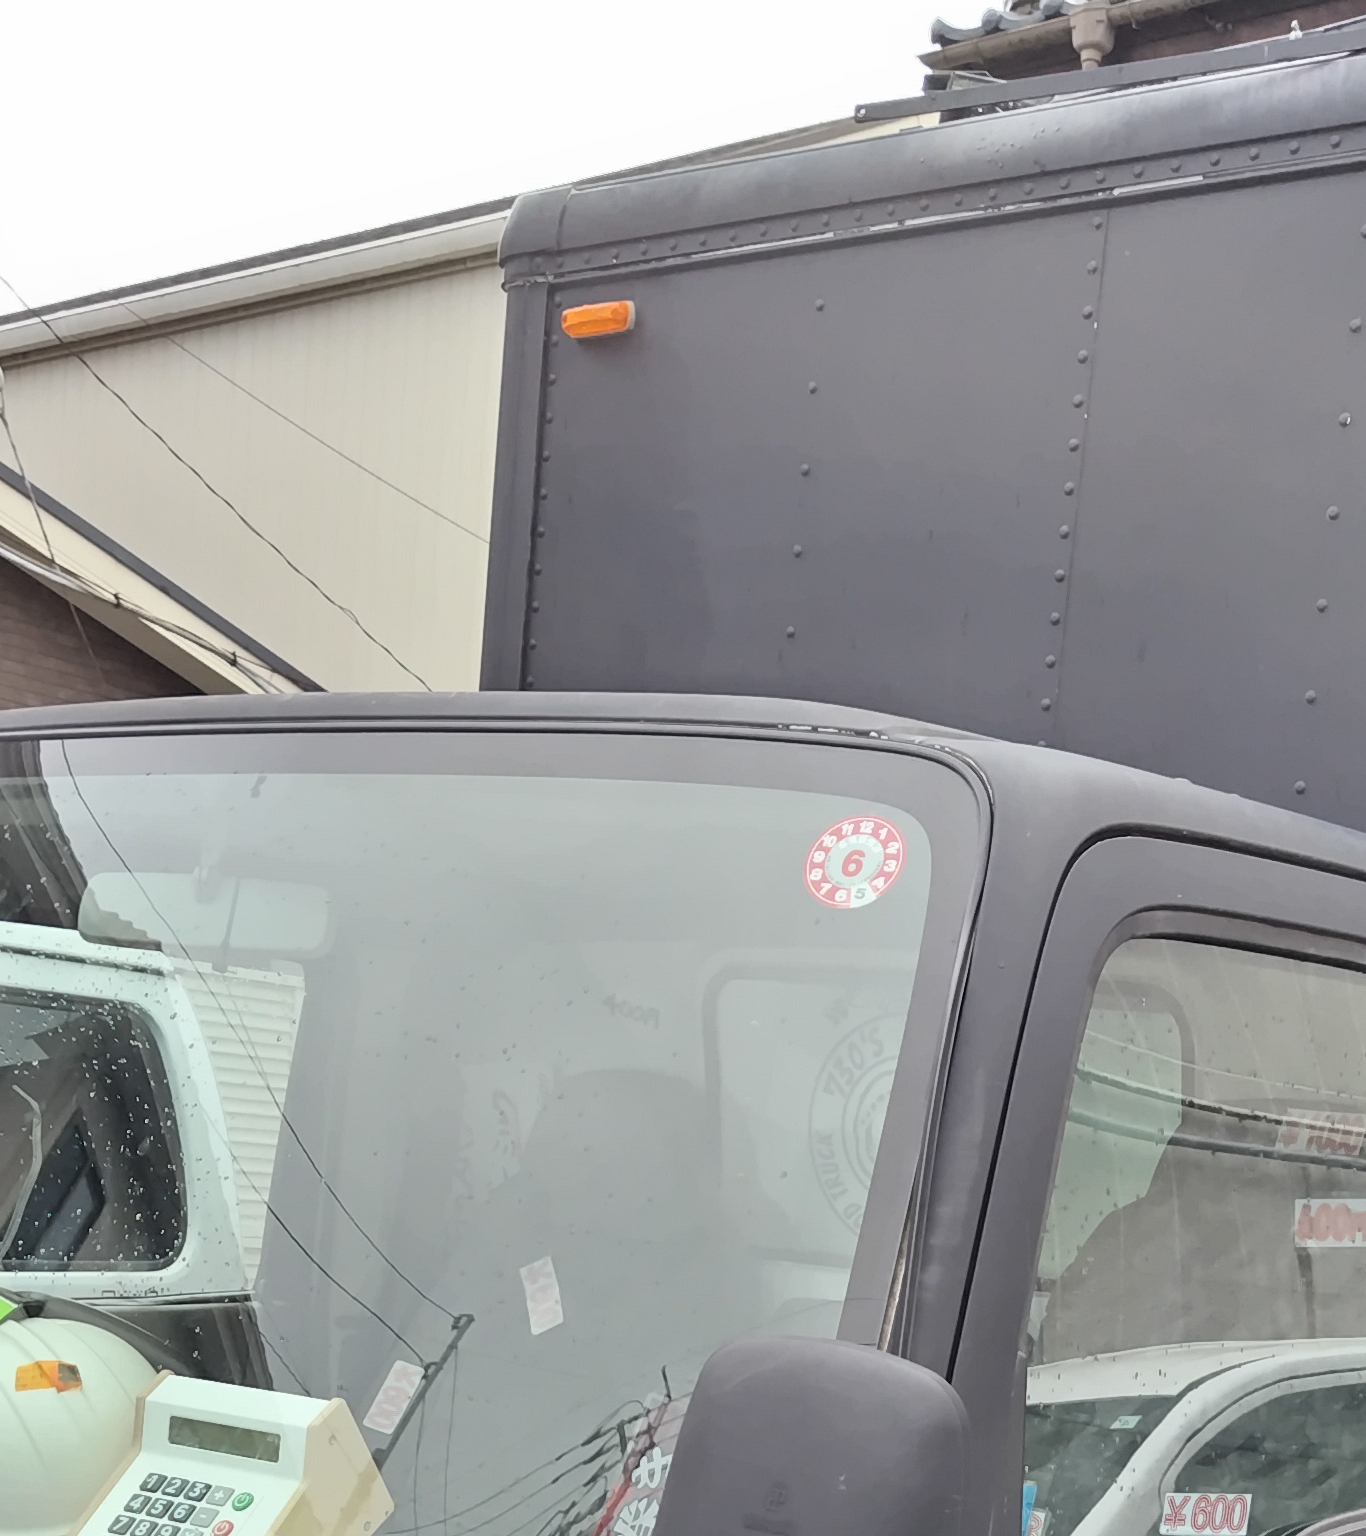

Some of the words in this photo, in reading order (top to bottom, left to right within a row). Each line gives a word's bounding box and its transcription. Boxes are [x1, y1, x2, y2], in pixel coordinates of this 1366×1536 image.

[841, 823, 854, 835] 11
[859, 821, 874, 833] 12
[878, 828, 888, 839] 1
[822, 835, 837, 847] 10
[885, 841, 899, 854] 2
[813, 851, 825, 863] 9
[841, 849, 866, 877] 6
[883, 860, 897, 872] 3
[810, 868, 823, 880] 8
[819, 883, 832, 895] 7
[872, 877, 885, 889] 4
[834, 889, 847, 902] 6
[854, 888, 866, 899] 5
[146, 1474, 159, 1490] 1
[167, 1479, 181, 1494] 2
[188, 1482, 203, 1497] 3
[129, 1495, 142, 1511] 4
[151, 1500, 165, 1514] 5
[174, 1504, 188, 1519] 6
[1164, 1494, 1247, 1533] ¥600
[114, 1517, 129, 1532] 7
[136, 1521, 150, 1536] 8
